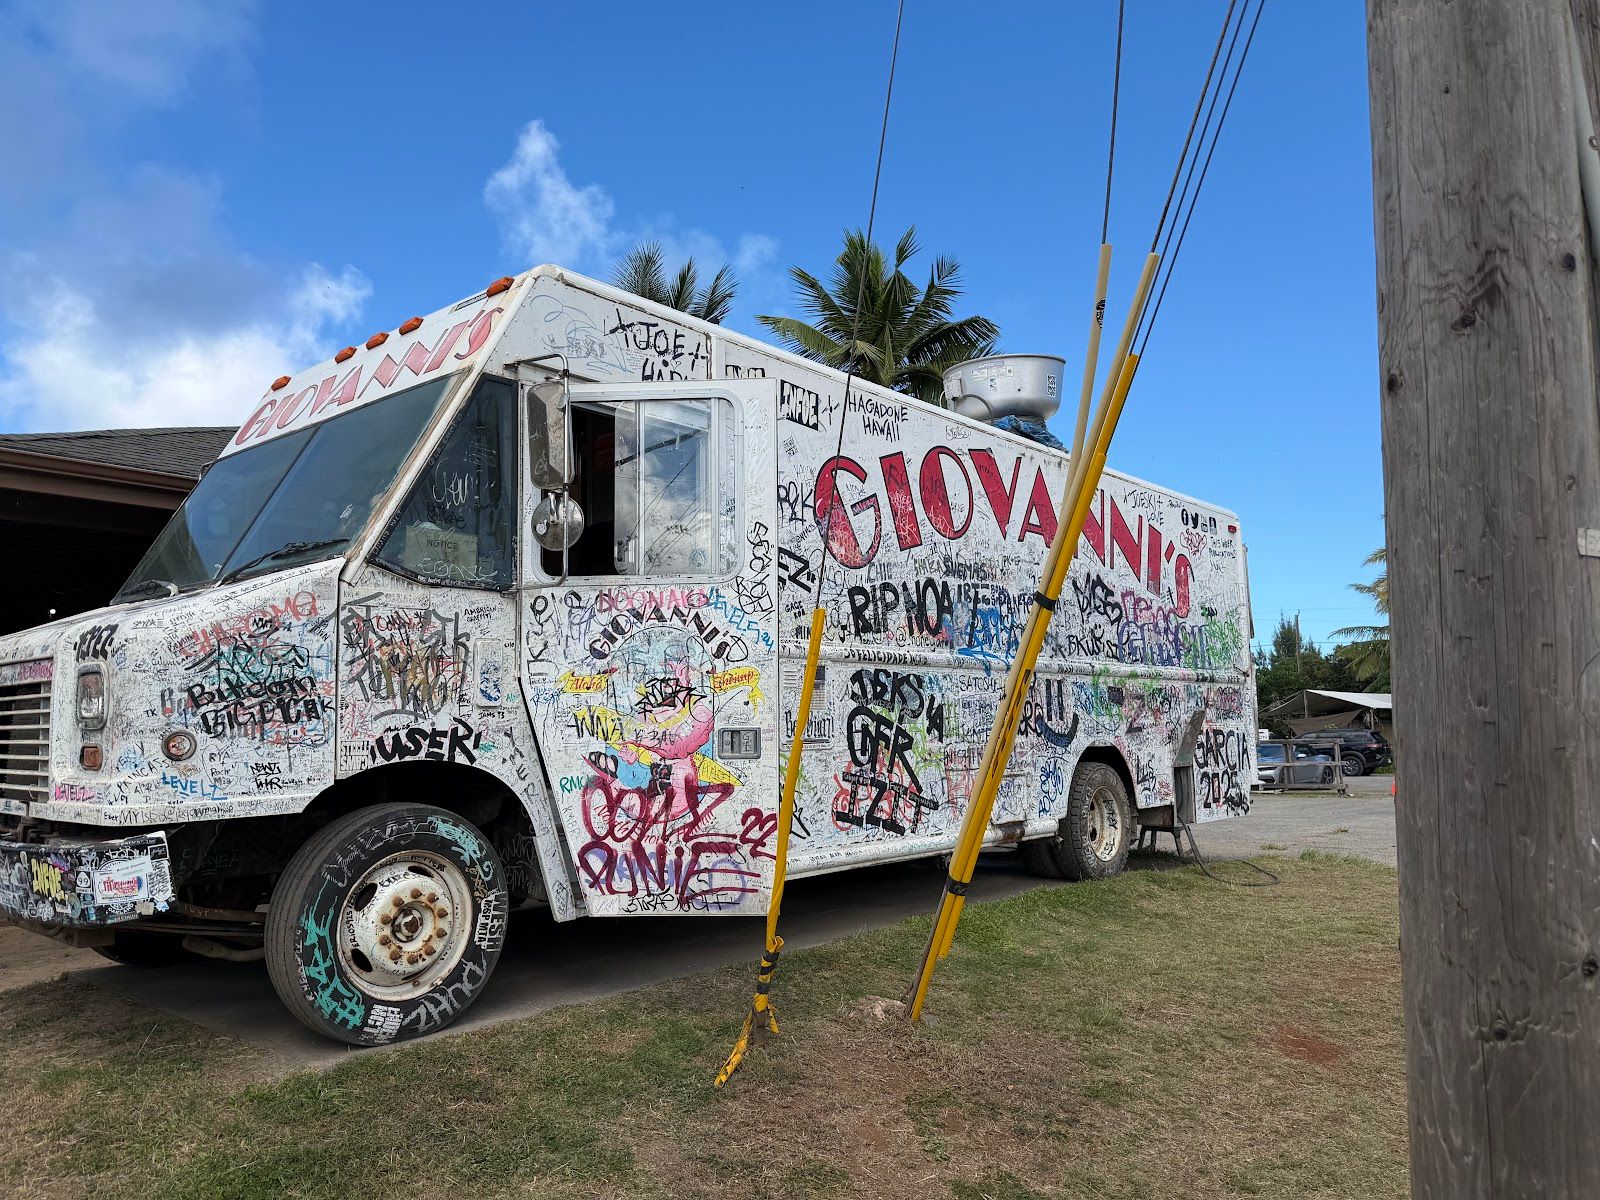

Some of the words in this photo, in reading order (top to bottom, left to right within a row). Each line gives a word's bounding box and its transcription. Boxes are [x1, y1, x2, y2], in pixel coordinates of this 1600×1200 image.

[235, 307, 504, 446] GIOVANNI'S
[848, 390, 909, 423] HAGADONE
[862, 414, 900, 443] HAWAII
[813, 445, 1195, 619] GIOVANNI'S
[589, 603, 731, 660] GIOVANNI'S
[376, 717, 476, 765] USER
[1194, 729, 1251, 771] GARCIA
